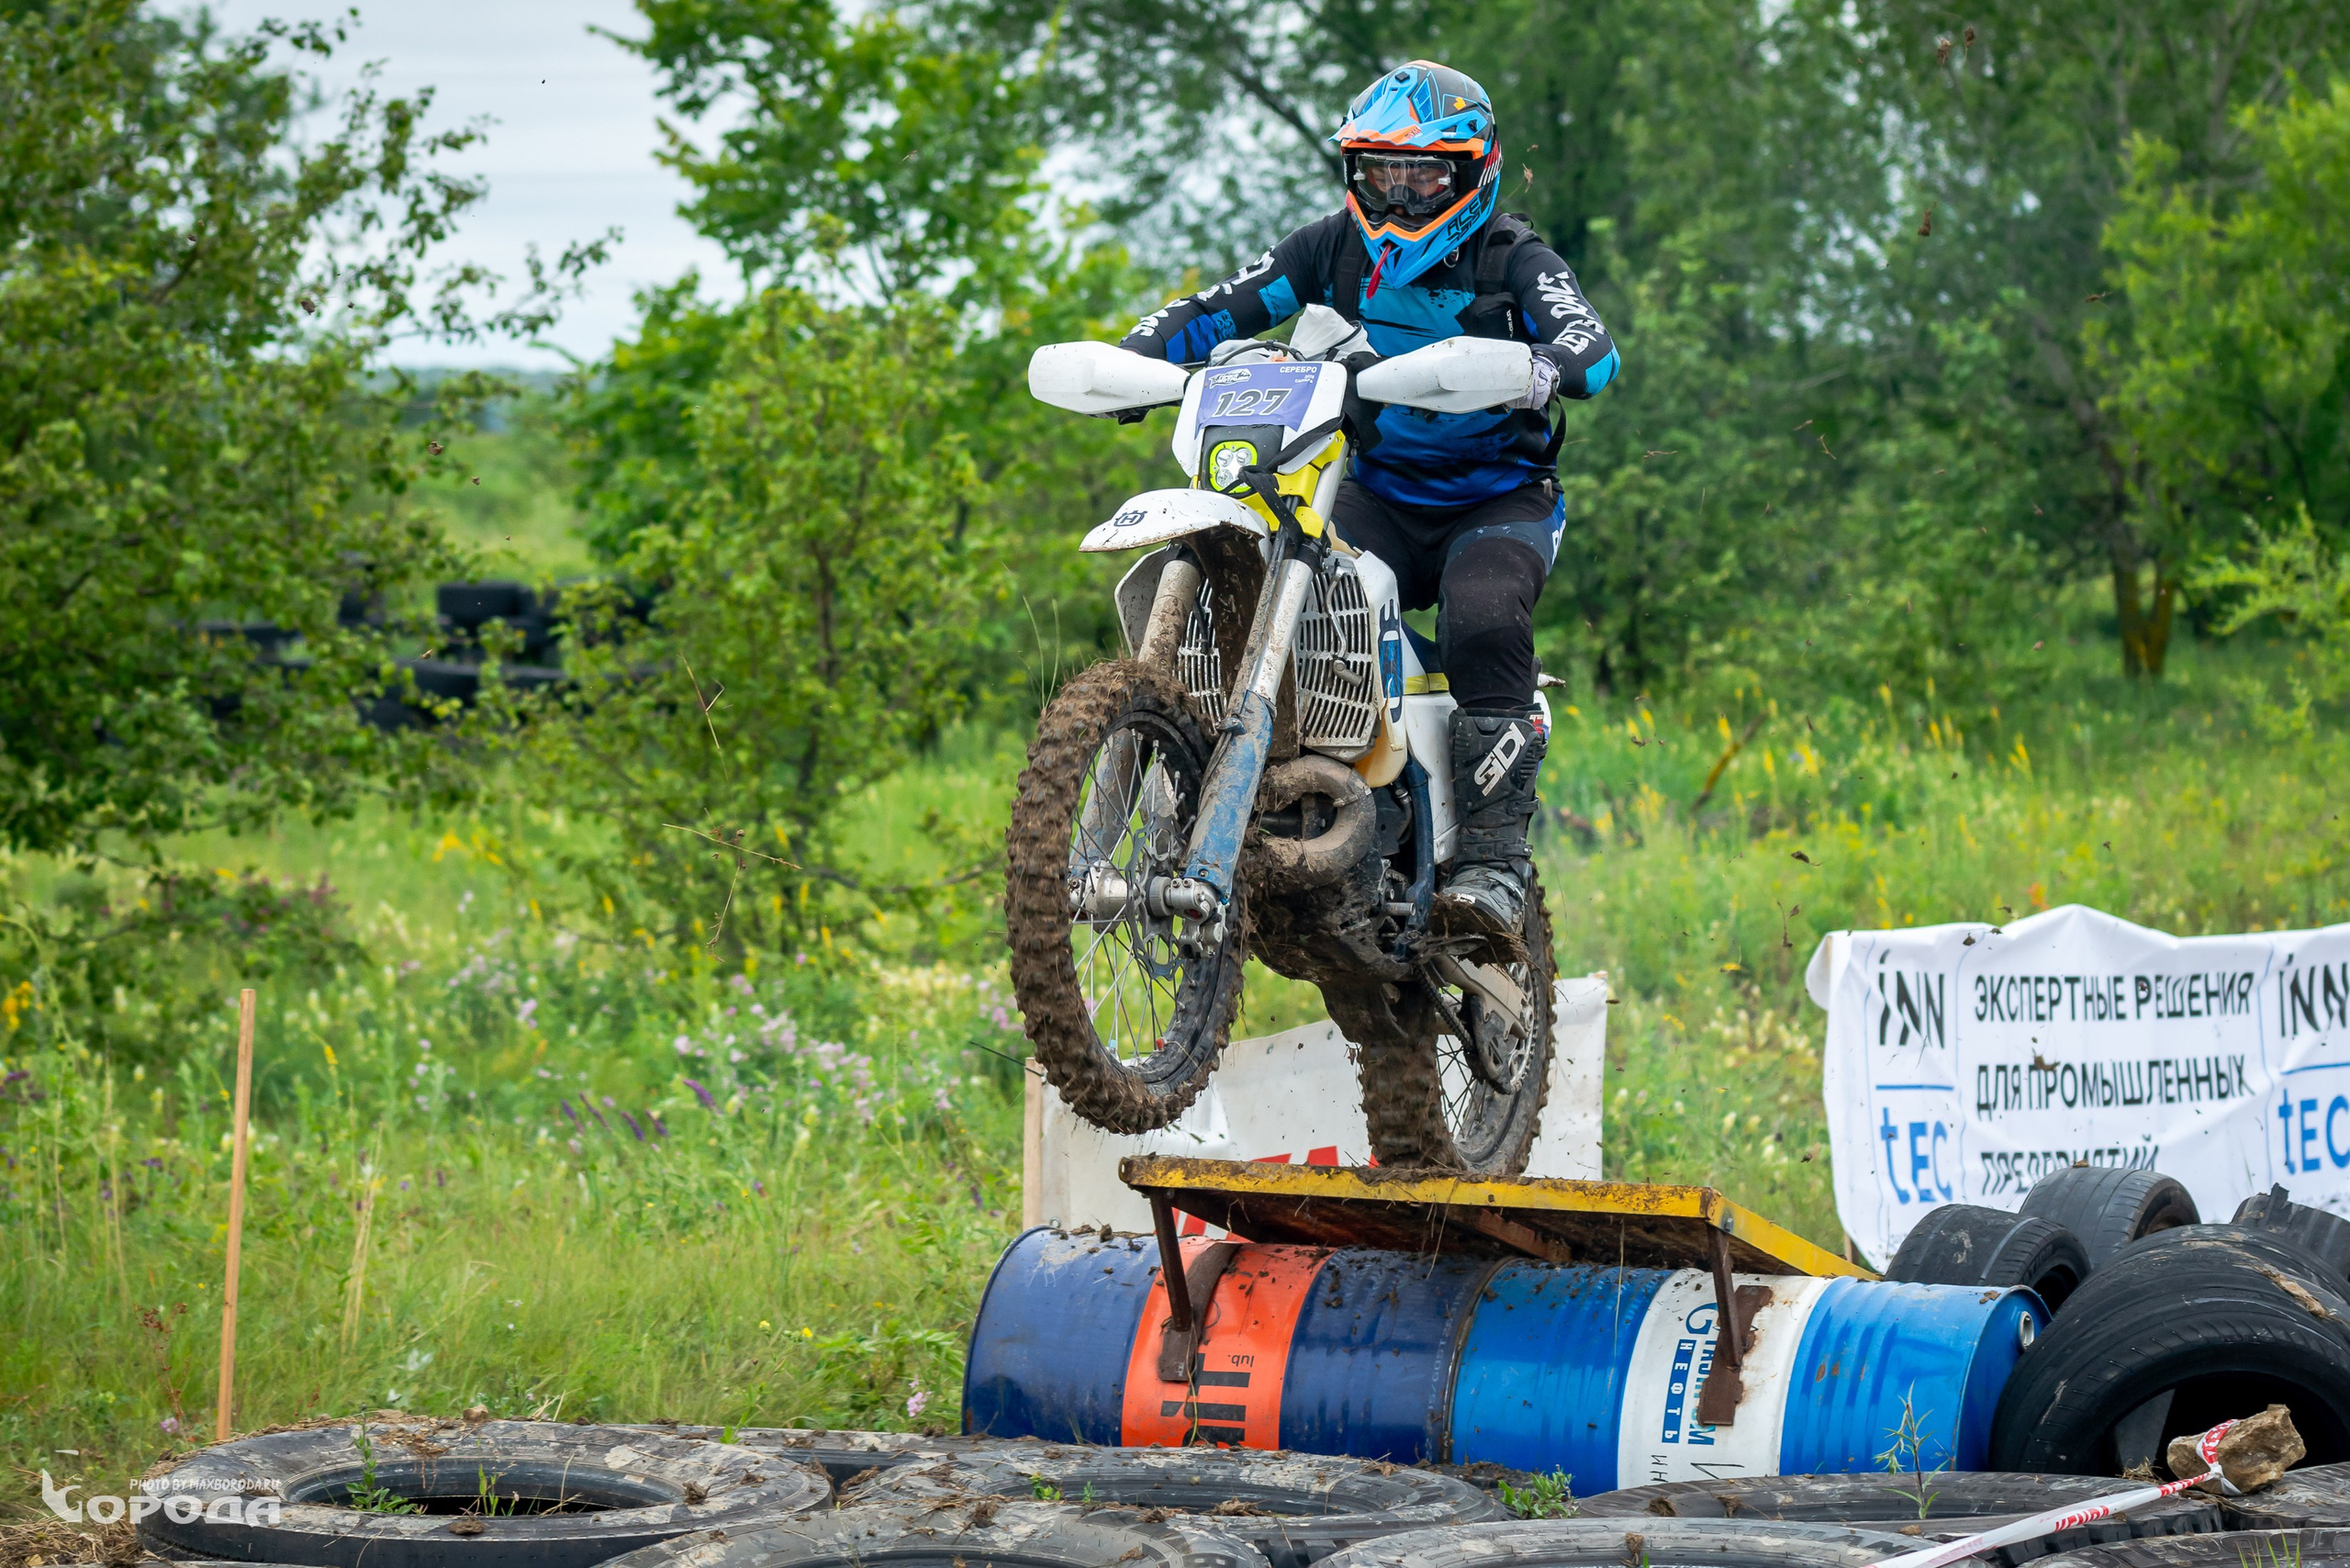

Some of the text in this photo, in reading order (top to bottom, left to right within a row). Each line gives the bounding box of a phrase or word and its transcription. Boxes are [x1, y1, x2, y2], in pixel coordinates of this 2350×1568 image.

[1280, 365, 1317, 374] СЕРЕБРО
[1212, 388, 1292, 418] 127
[1975, 972, 2255, 1023] ЭКСПЕРТНЫЕ РЕШЕНИЯ
[1976, 1055, 2255, 1121] ДЛЯ ПРОМЫШЛЕННЫХ
[1663, 1341, 1695, 1440] НЕФТЬ
